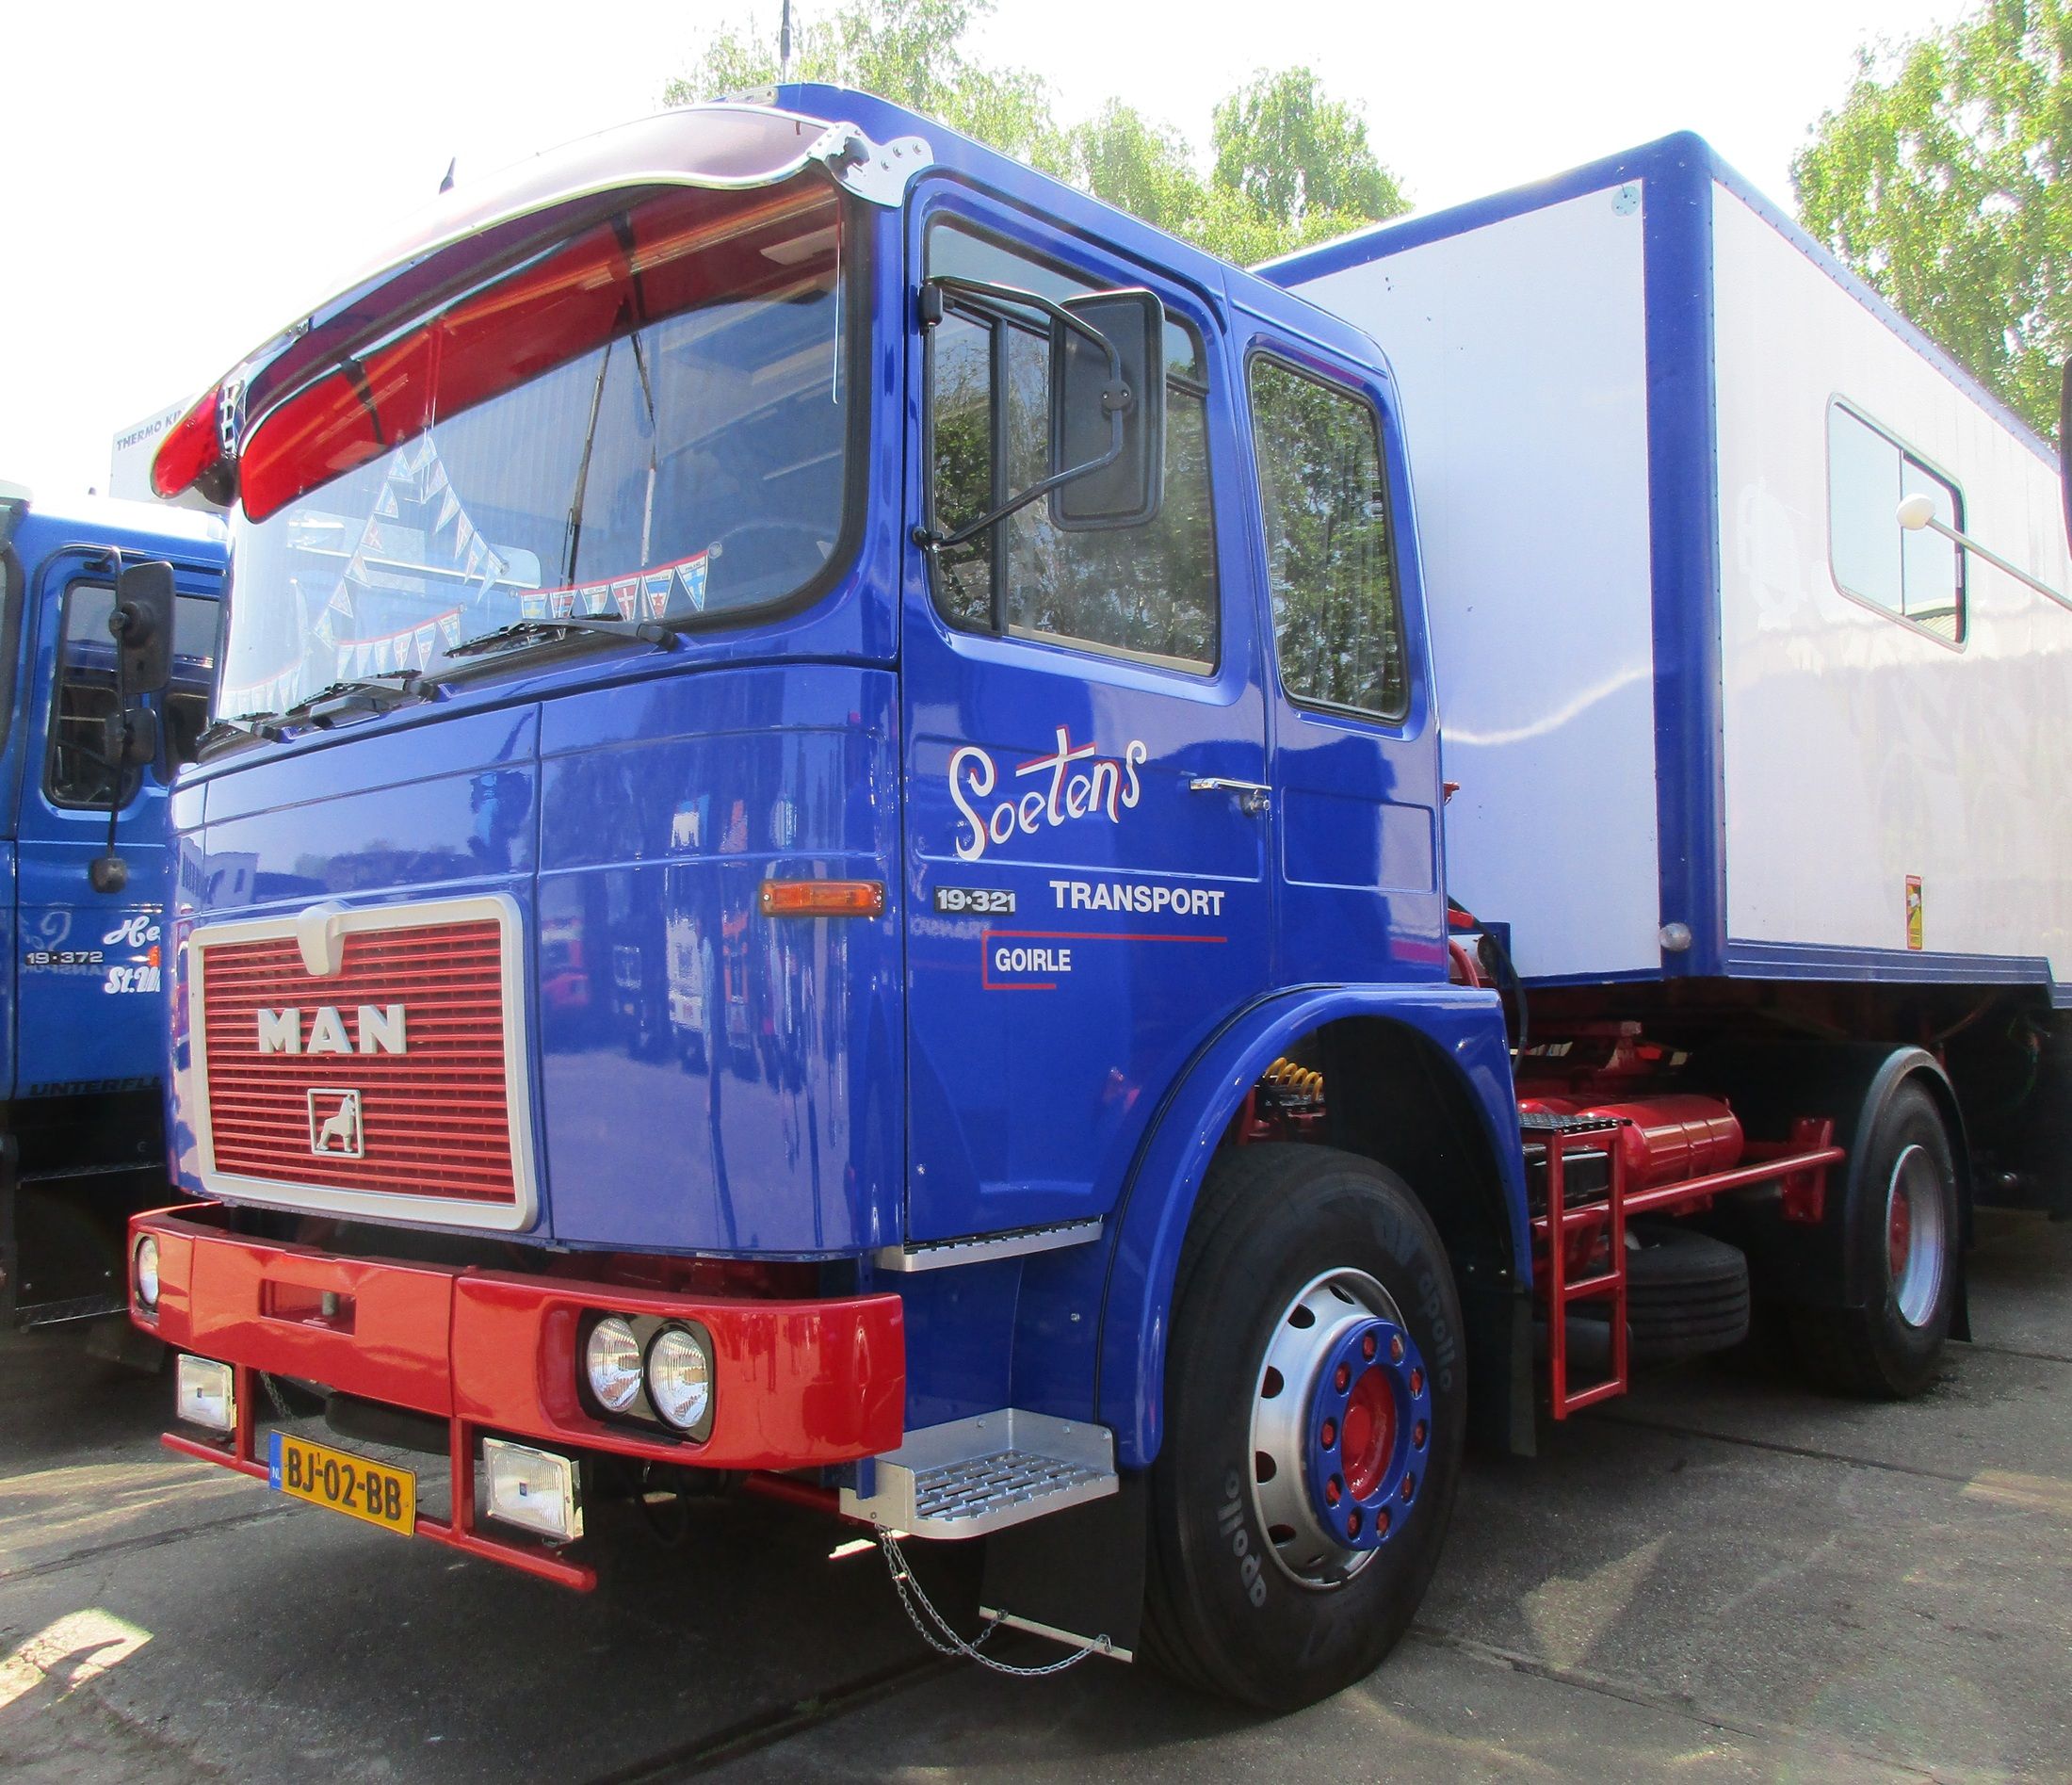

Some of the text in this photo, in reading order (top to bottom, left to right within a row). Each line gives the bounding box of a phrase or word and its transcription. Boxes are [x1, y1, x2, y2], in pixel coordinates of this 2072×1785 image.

[116, 420, 162, 451] THERMO
[949, 724, 1147, 861] Soetens
[1048, 880, 1225, 916] TRANSPORT
[995, 948, 1072, 972] GOIRLE
[257, 1003, 408, 1055] MAN
[1417, 1272, 1456, 1392] apollo
[271, 1466, 282, 1481] NL
[287, 1446, 402, 1521] BJ-02-BB
[1217, 1468, 1267, 1608] apollo
